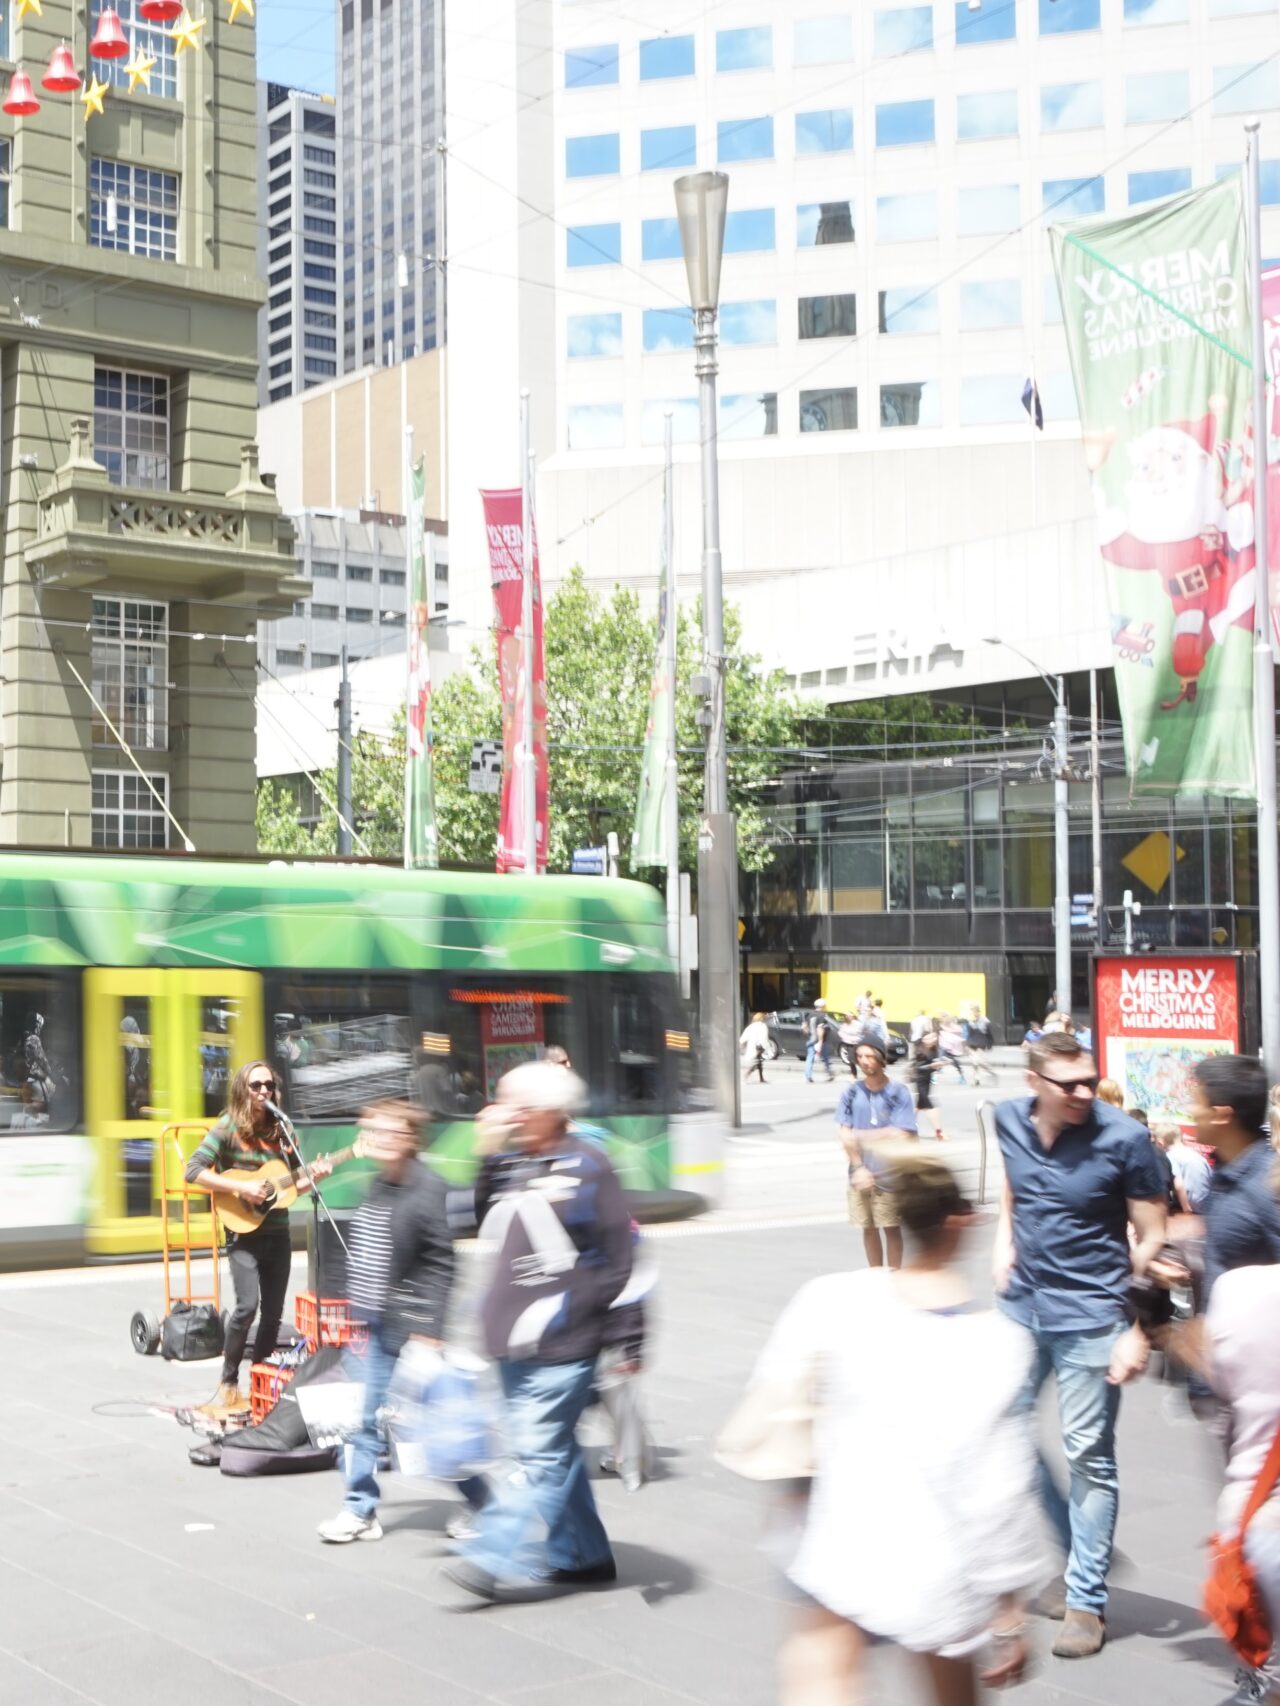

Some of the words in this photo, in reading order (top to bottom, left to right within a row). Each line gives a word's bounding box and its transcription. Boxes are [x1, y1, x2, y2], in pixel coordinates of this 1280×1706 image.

[1121, 968, 1216, 994] MERRY
[1119, 992, 1216, 1014] CHRISTMAS
[1122, 1013, 1216, 1030] MELBOURNE
